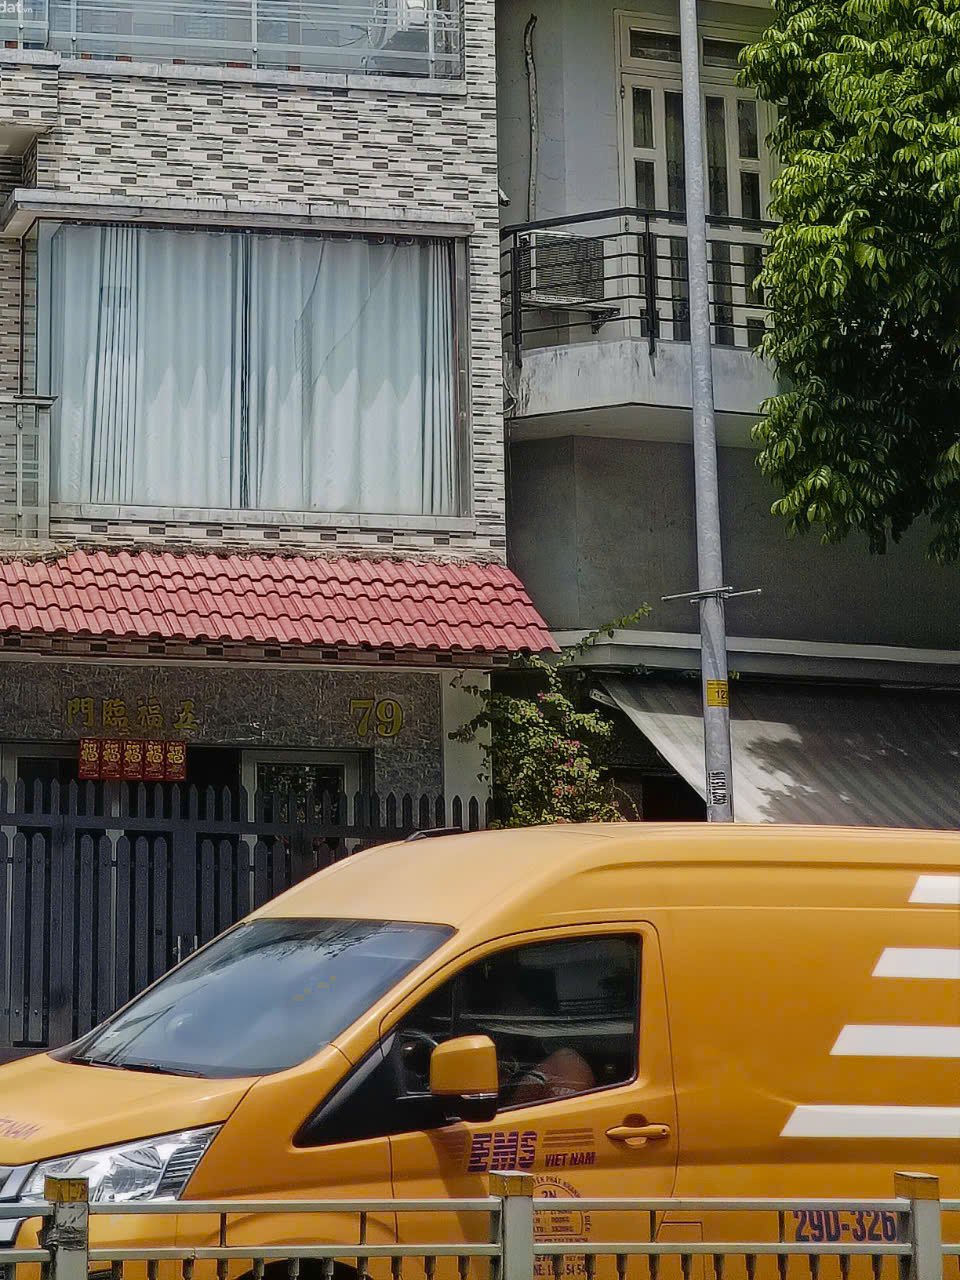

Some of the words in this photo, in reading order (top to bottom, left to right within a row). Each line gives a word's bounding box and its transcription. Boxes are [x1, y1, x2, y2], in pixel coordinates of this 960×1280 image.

[349, 698, 403, 737] 79
[467, 1131, 537, 1172] EMS
[569, 1152, 596, 1166] NAM
